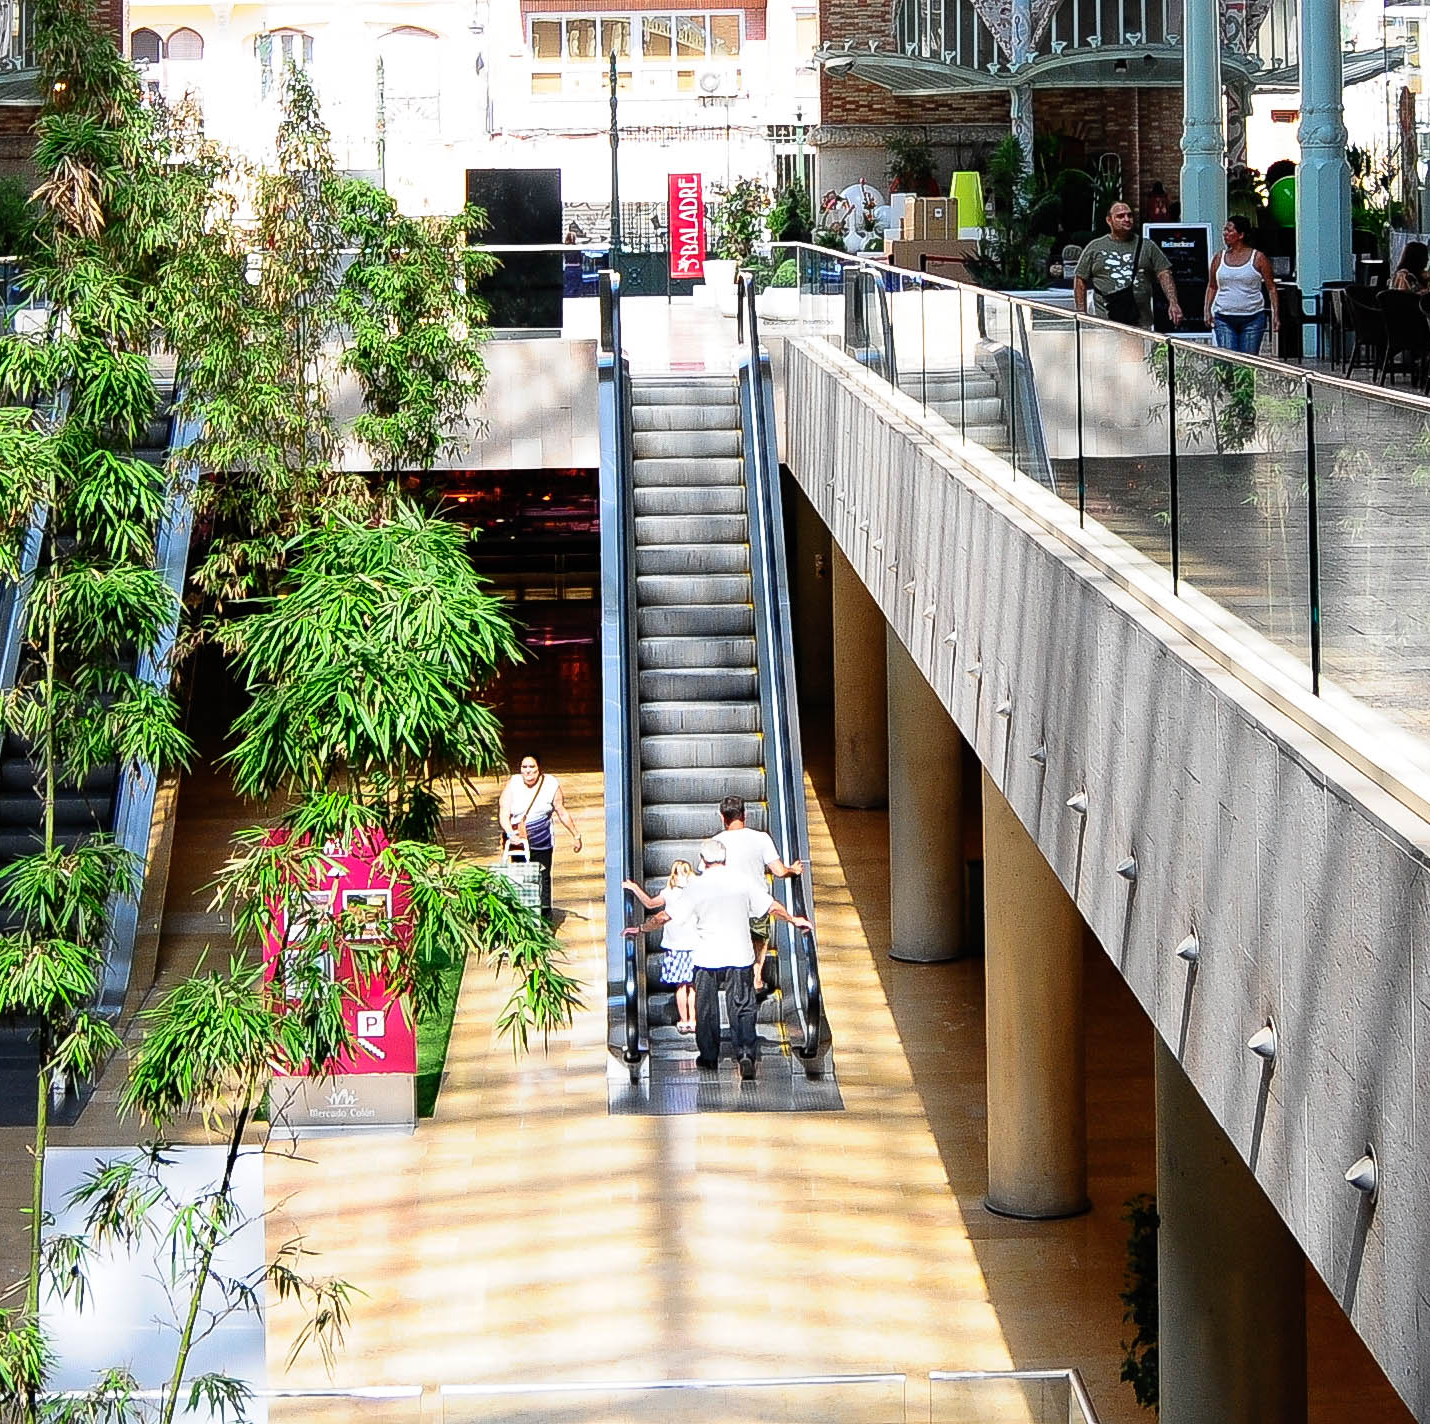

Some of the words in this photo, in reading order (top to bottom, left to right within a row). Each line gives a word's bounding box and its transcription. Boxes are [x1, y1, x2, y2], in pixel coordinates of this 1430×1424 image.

[678, 175, 699, 255] BALADRE
[366, 1016, 378, 1032] P
[309, 1108, 347, 1118] Mercado
